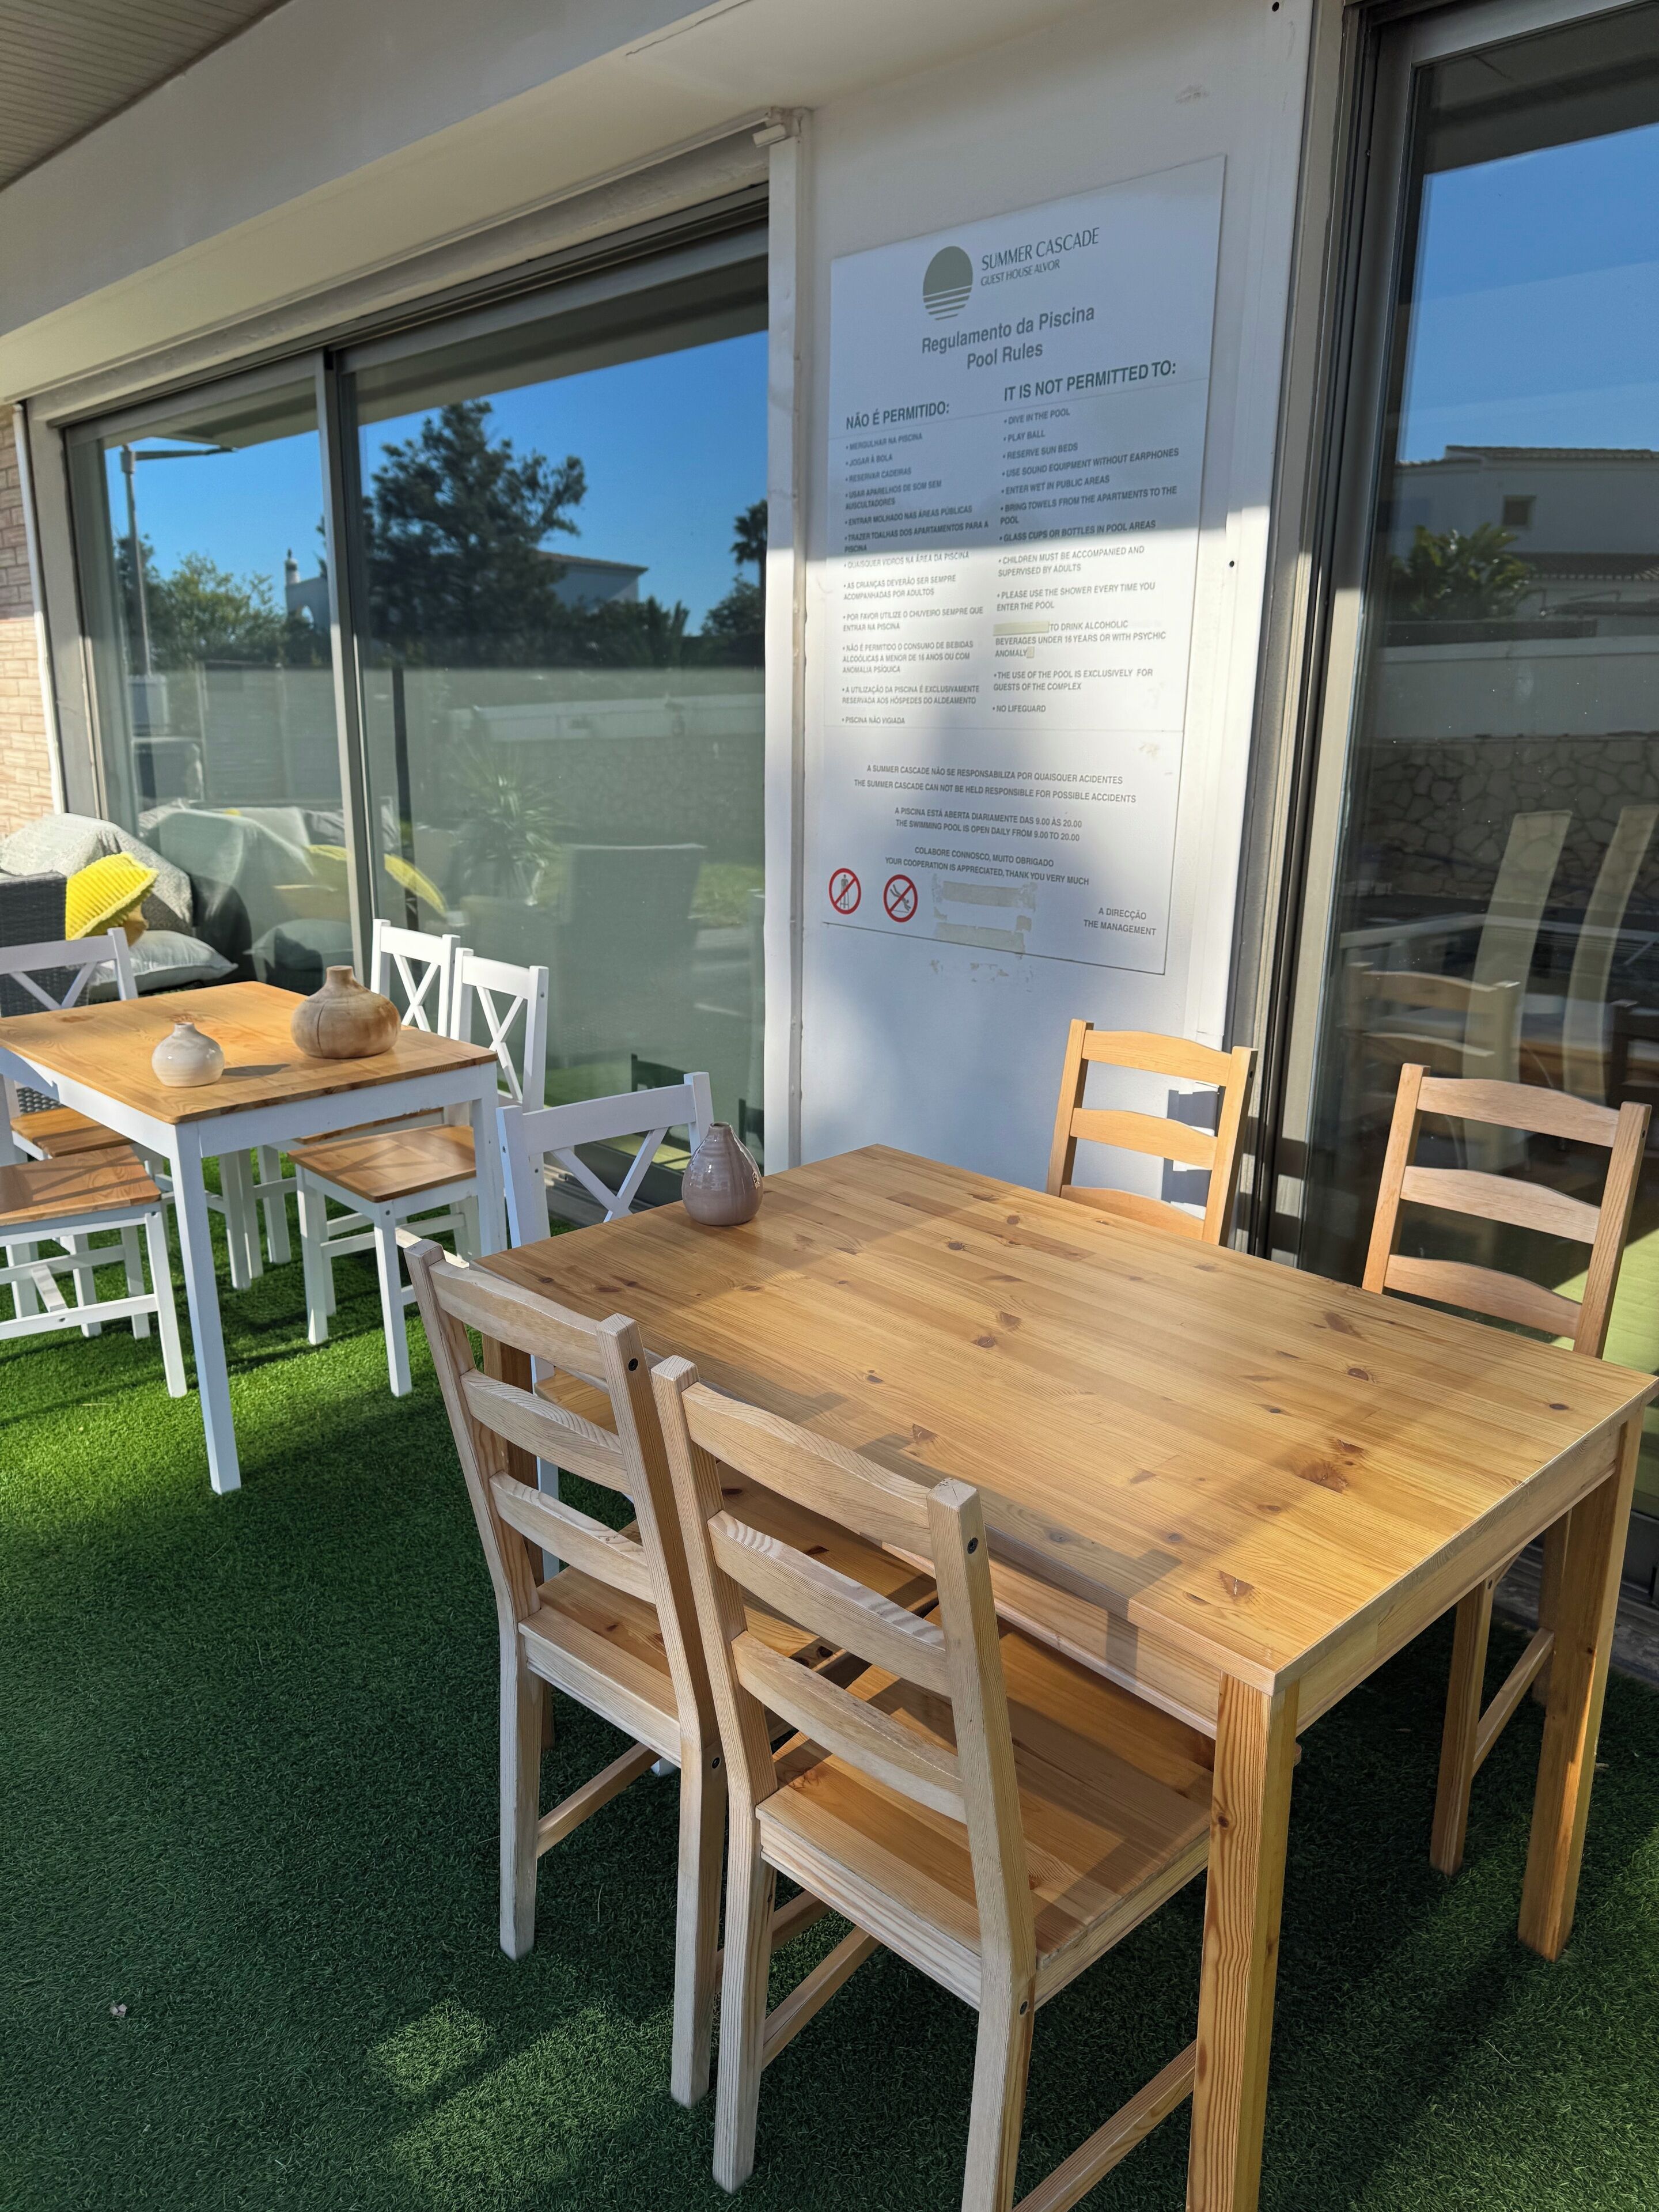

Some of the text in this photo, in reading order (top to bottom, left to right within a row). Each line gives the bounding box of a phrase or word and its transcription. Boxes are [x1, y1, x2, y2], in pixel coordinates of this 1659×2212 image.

[981, 227, 1099, 271] SUMMER CASCADE
[980, 259, 1060, 286] GUEST HOUSE ALVOR
[922, 306, 1094, 354] Regulamento da Piscina
[967, 342, 1043, 370] Pool Rules
[1004, 359, 1176, 402] IT IS NOT PERMITTED TO:
[846, 400, 949, 430] NÃO É PERMITIDO:
[1007, 407, 1070, 425] DIVE IN THE POOL
[1007, 429, 1045, 442] PLAY BALL
[1006, 442, 1078, 460] RESERVE SUN BEDS
[1006, 447, 1179, 478] USE SOUND EQUIPMENT WITHOUT EARPHONES
[1005, 474, 1110, 495] ENTER WET IN PUBLIC AREAS
[1003, 520, 1156, 542] GLASS CUPS OR BOTTLES IN POOL AREAS
[1002, 545, 1145, 565] CHILDREN MUST BE ACCOMPANIED AND
[998, 563, 1081, 577] SUPERVISED BY ADULTS
[1001, 581, 1156, 599] PLEASE USE THE SHOWER EVERY TIME YOU
[996, 600, 1054, 612] ENTER THE POOL
[1048, 620, 1128, 631] TO DRINK ALCOHOLIC
[995, 635, 1037, 646] BEVERAGES
[1037, 635, 1062, 644] UNDER
[1073, 634, 1097, 643] YEARS
[1099, 633, 1111, 642] OR
[1111, 632, 1131, 641] WITH
[1132, 631, 1166, 641] PSYCHIC
[994, 649, 1027, 657] ANOMALY
[996, 704, 1046, 713] NO LIFEGUARD
[872, 764, 899, 773] SUMMER
[900, 766, 930, 775] CASCADE
[931, 766, 945, 775] NÃO
[946, 768, 956, 776] SE
[956, 768, 1016, 779] RESPONSABILIZA
[1017, 771, 1032, 780] POR
[1033, 772, 1077, 782] QUAISQUER
[1078, 774, 1123, 785] ACIDENTES
[854, 779, 1136, 803] THE SUMMER CASCADE CAN NOT BE HELD RESPONSIBLE FOR POSSIBLE ACCIDENTS
[900, 807, 926, 816] PISCINA
[926, 809, 943, 817] ESTÁ
[944, 810, 970, 819] ABERTA
[971, 812, 1018, 823] DIARIAMENTE
[1019, 816, 1034, 824] DAS
[1035, 817, 1050, 826] 9.00
[1051, 816, 1061, 827] ÀS
[1062, 819, 1082, 828] 20.00
[895, 819, 1080, 842] THE SWIMMING POOL IS OPEN DAILY FROM 9.00 TO 20.00
[914, 846, 1054, 867] COLABORE CONNOSCO, MUITO OBRIGADO
[885, 857, 1089, 885] YOUR COOPERATION IS APPRECIATED, THANK YOU VERY MUCH
[1098, 906, 1146, 922] A DIRECÇÃO
[1084, 919, 1156, 935] THE MANAGEMENT
